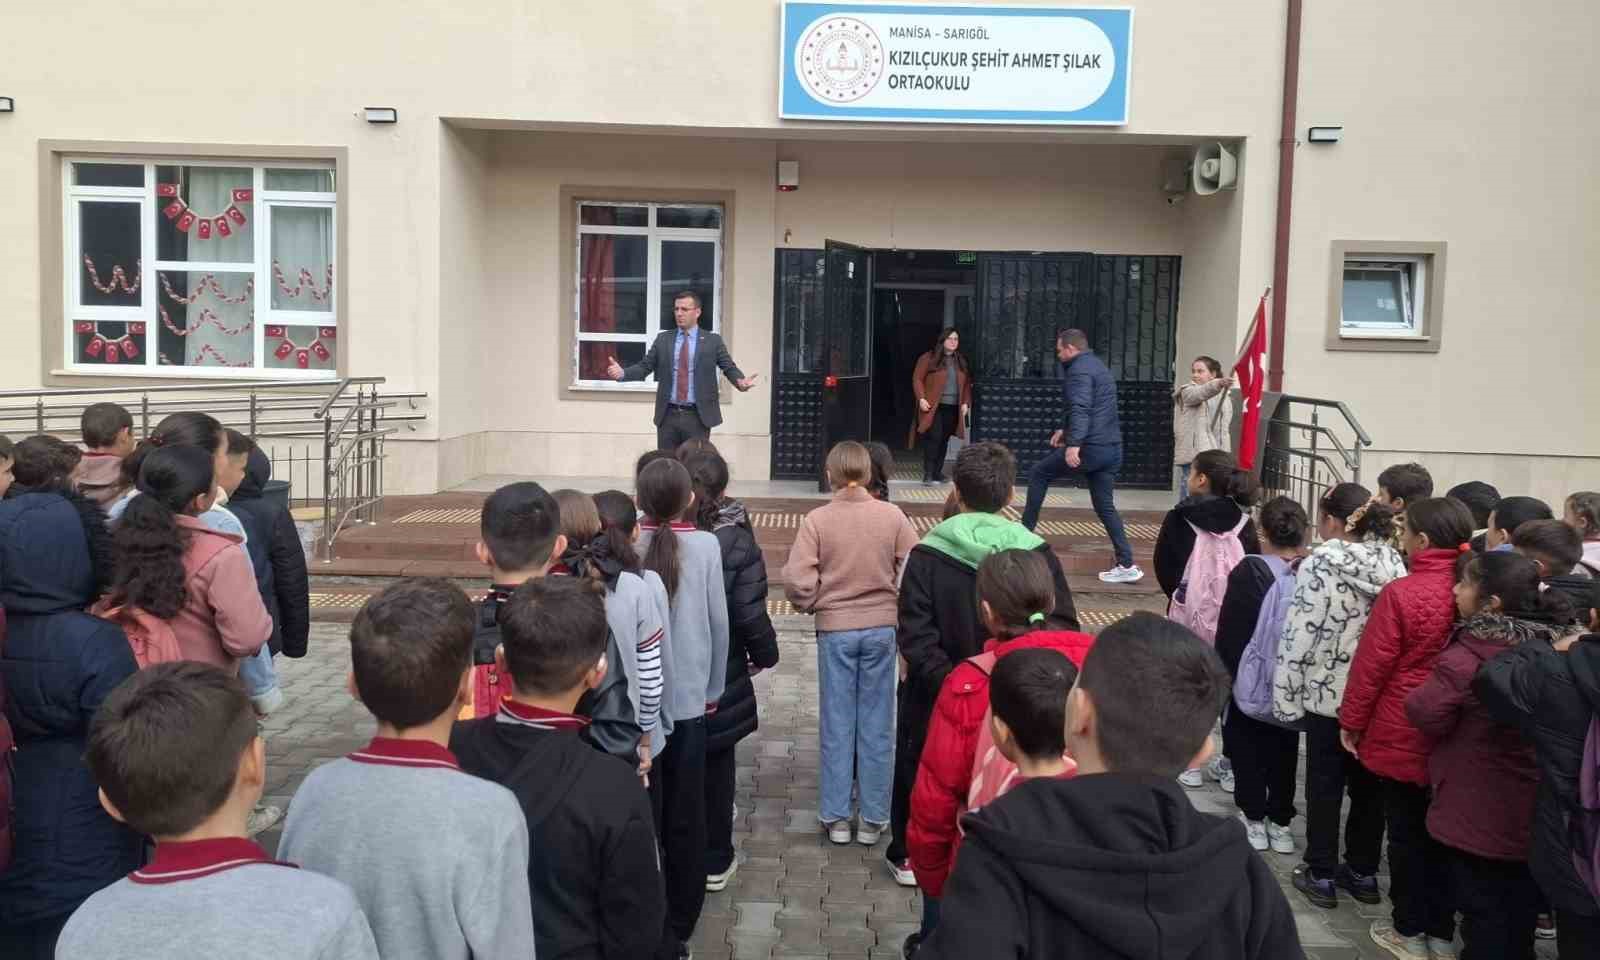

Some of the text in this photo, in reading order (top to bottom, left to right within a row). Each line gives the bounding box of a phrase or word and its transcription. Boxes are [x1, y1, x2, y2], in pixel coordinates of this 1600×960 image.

[889, 25, 932, 38] MANİSA
[943, 26, 989, 40] SARIGÖL
[889, 49, 1101, 73] KIZILÇUKUR ŞEHİT AHMET ŞILAK
[888, 74, 970, 91] ORTAOKULU
